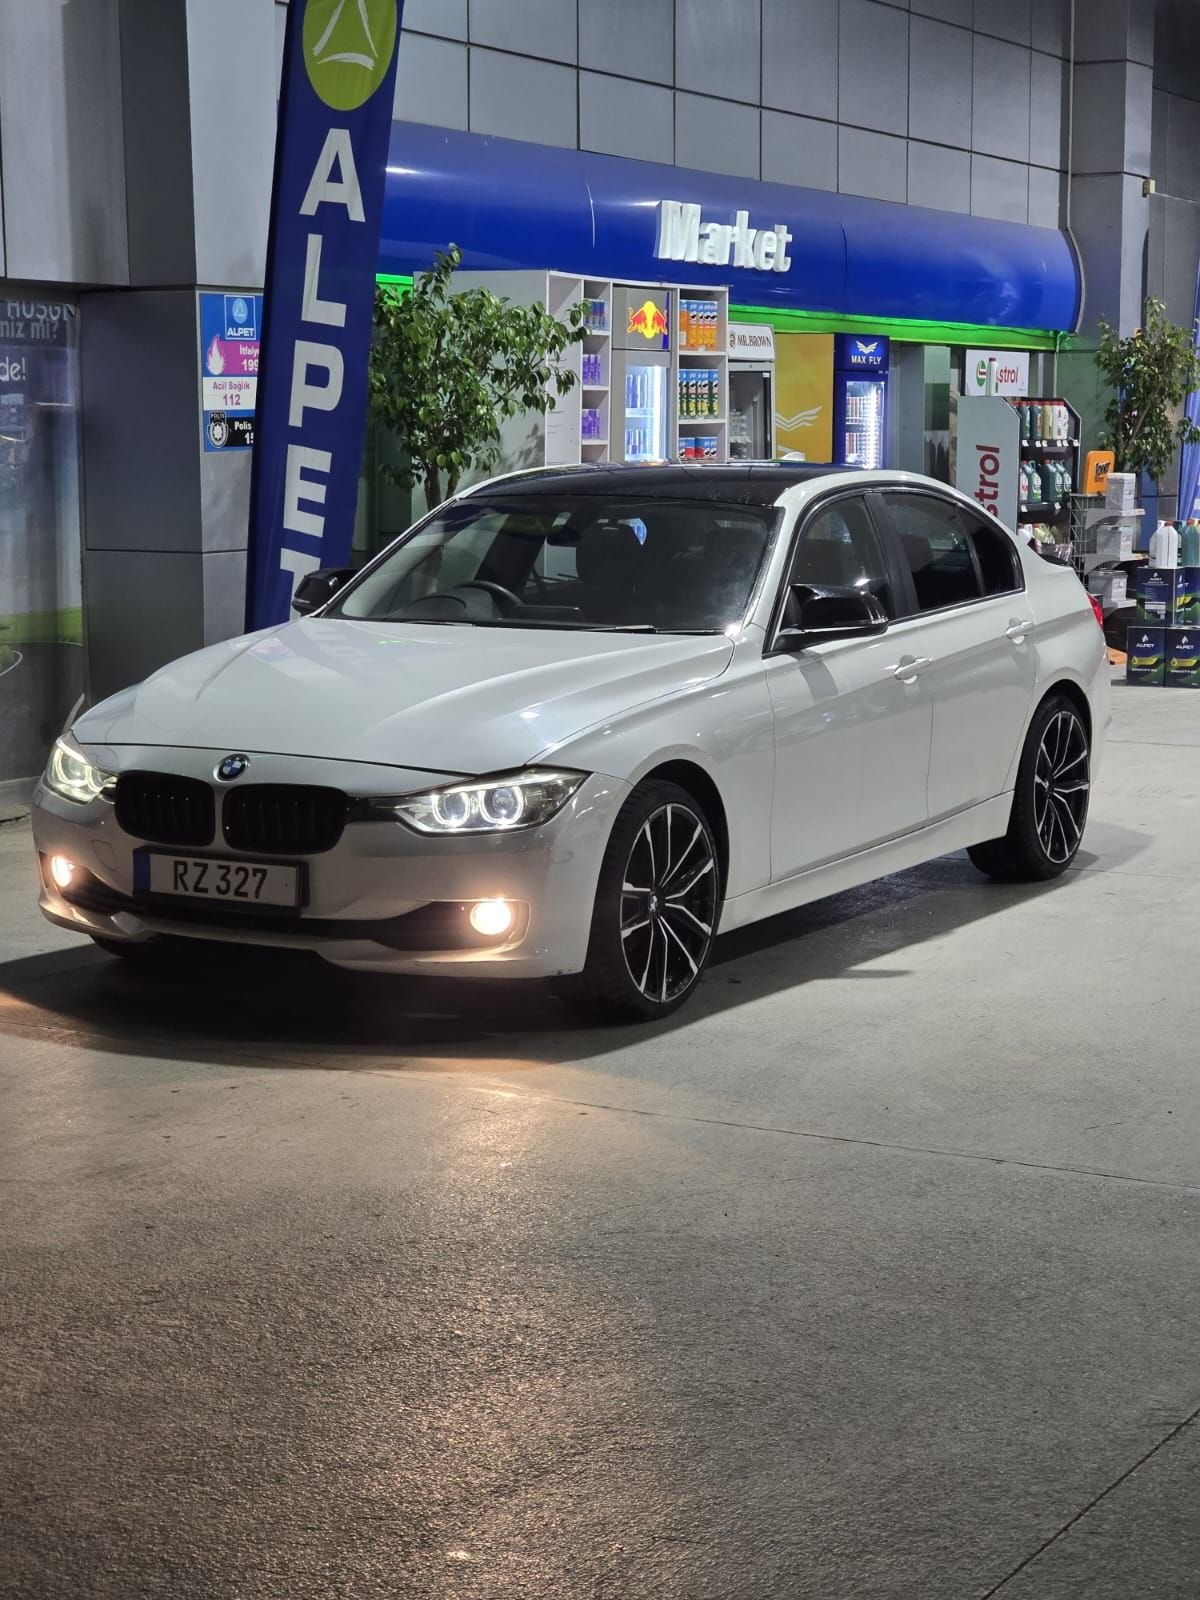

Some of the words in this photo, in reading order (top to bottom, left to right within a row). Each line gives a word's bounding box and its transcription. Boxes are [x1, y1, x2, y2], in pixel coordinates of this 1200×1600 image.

[655, 200, 791, 272] Market
[227, 327, 255, 337] ALPET
[851, 354, 867, 365] MAX
[868, 355, 882, 366] FLY
[280, 127, 366, 621] ALPET
[996, 366, 1019, 384] strol
[213, 381, 227, 390] Acil
[222, 394, 241, 406] 112
[234, 421, 252, 431] Polis
[975, 444, 1000, 517] strol
[173, 859, 209, 894] RZ
[215, 864, 268, 899] 327
